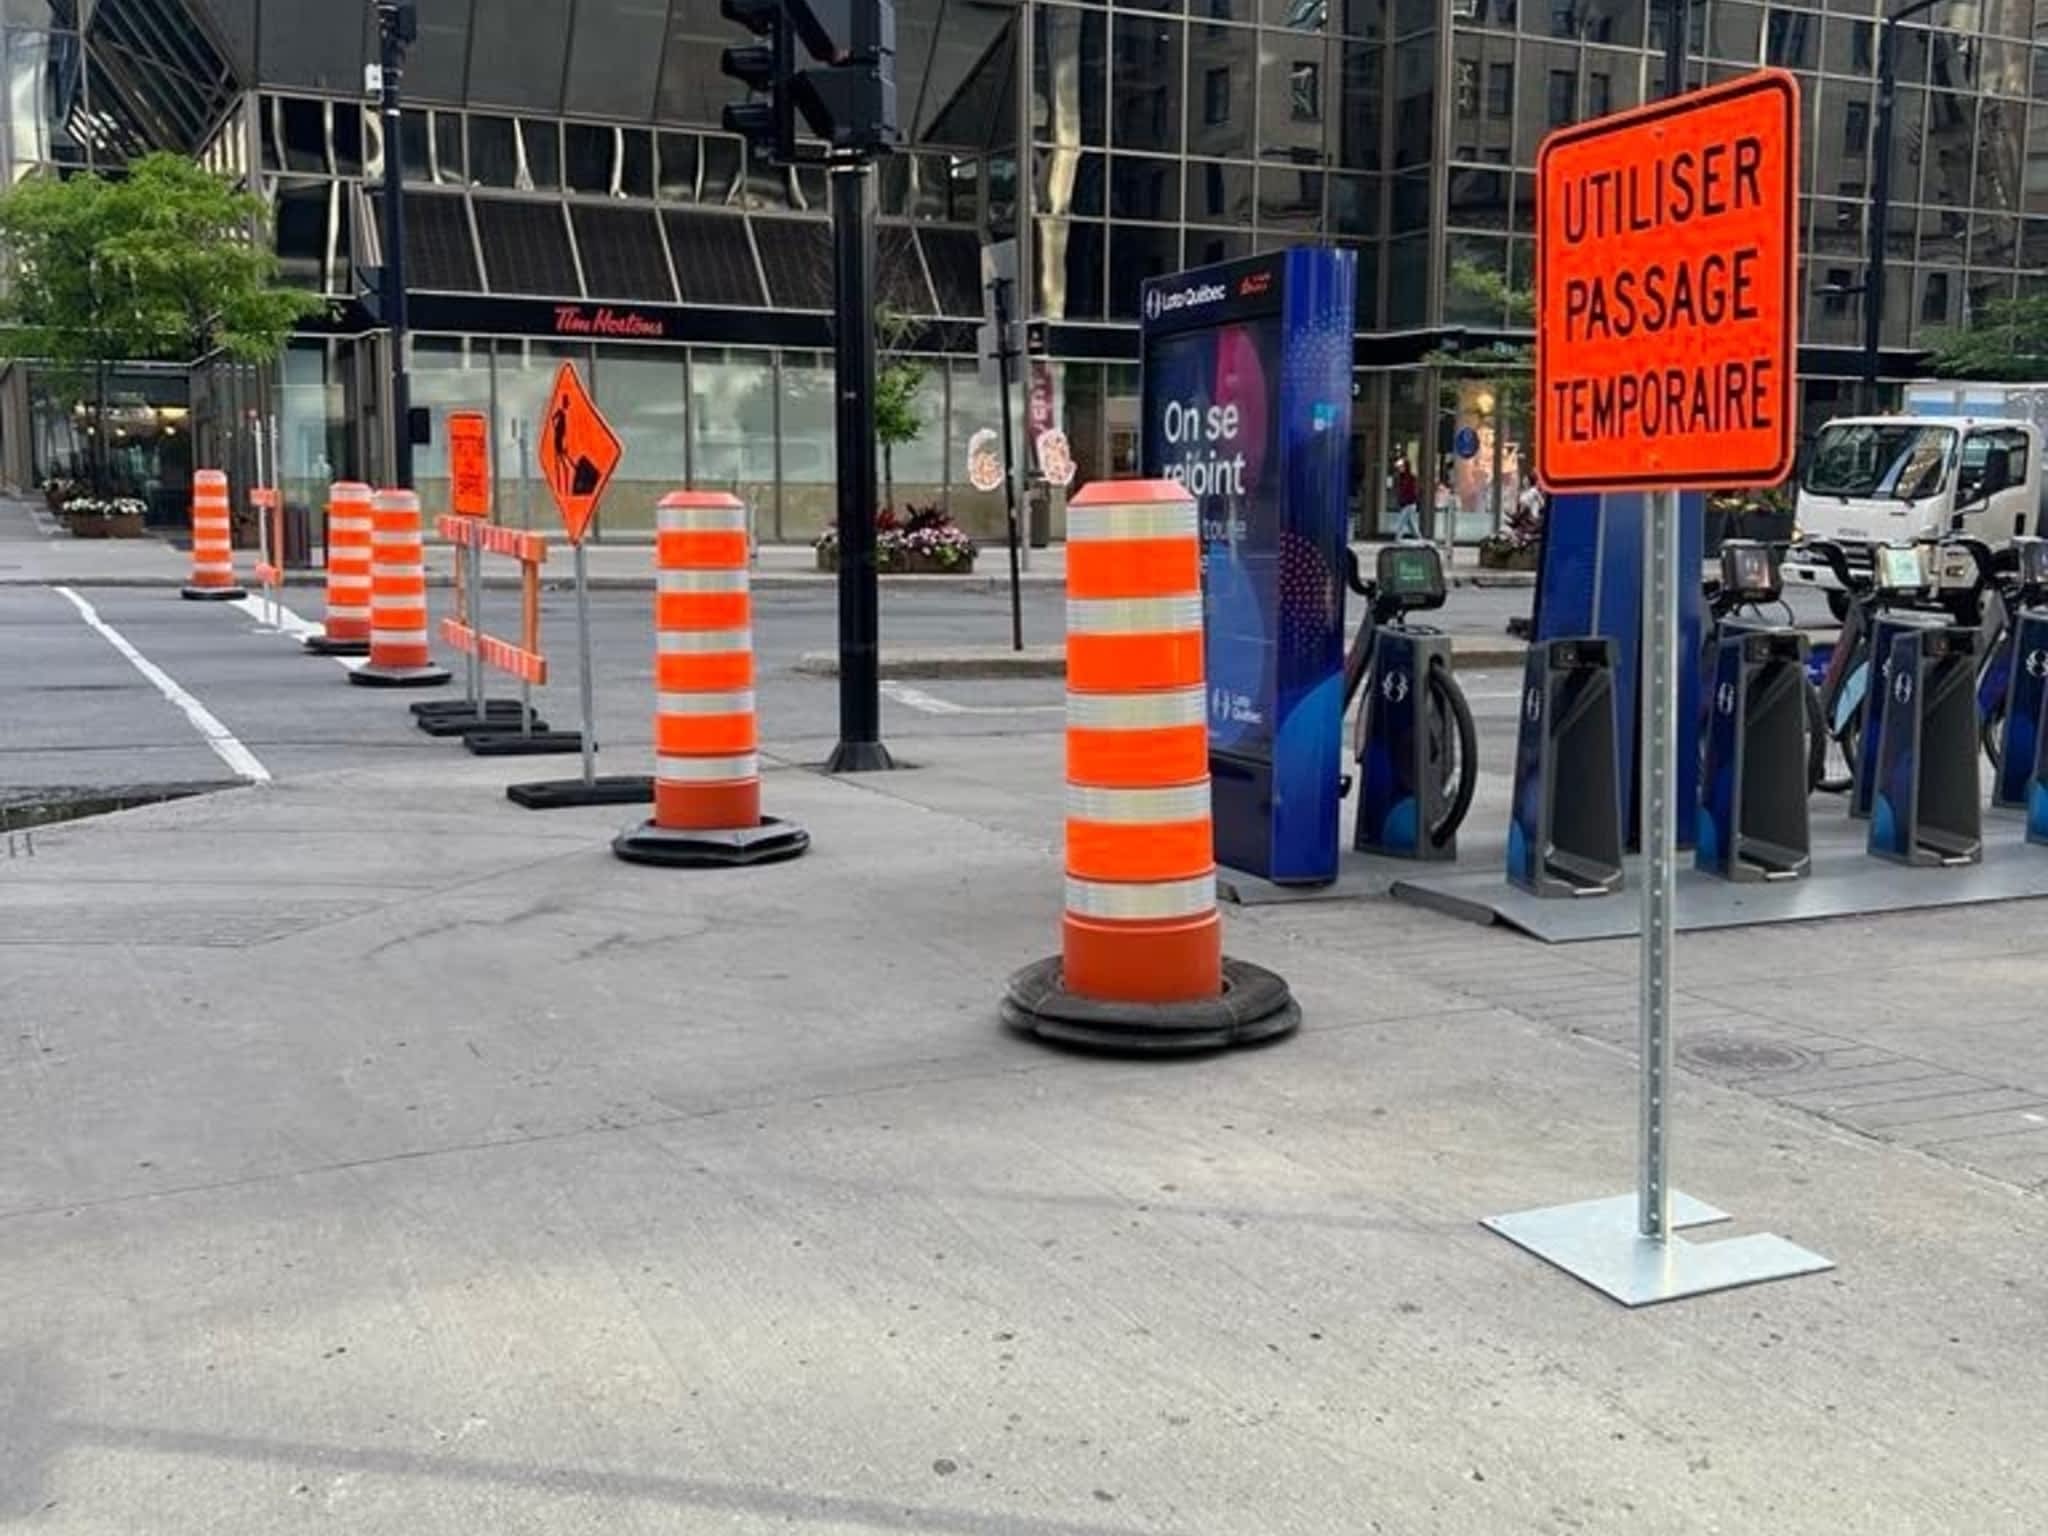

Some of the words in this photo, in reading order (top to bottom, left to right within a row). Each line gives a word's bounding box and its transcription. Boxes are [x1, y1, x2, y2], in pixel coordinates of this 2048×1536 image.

[1564, 135, 1762, 244] UTILISER
[553, 306, 591, 331] Tim
[592, 307, 663, 336] Hortons
[1566, 247, 1759, 343] PASSAGE
[1164, 400, 1200, 444] On
[1204, 404, 1240, 441] se
[1553, 359, 1773, 444] TEMPORAIRE
